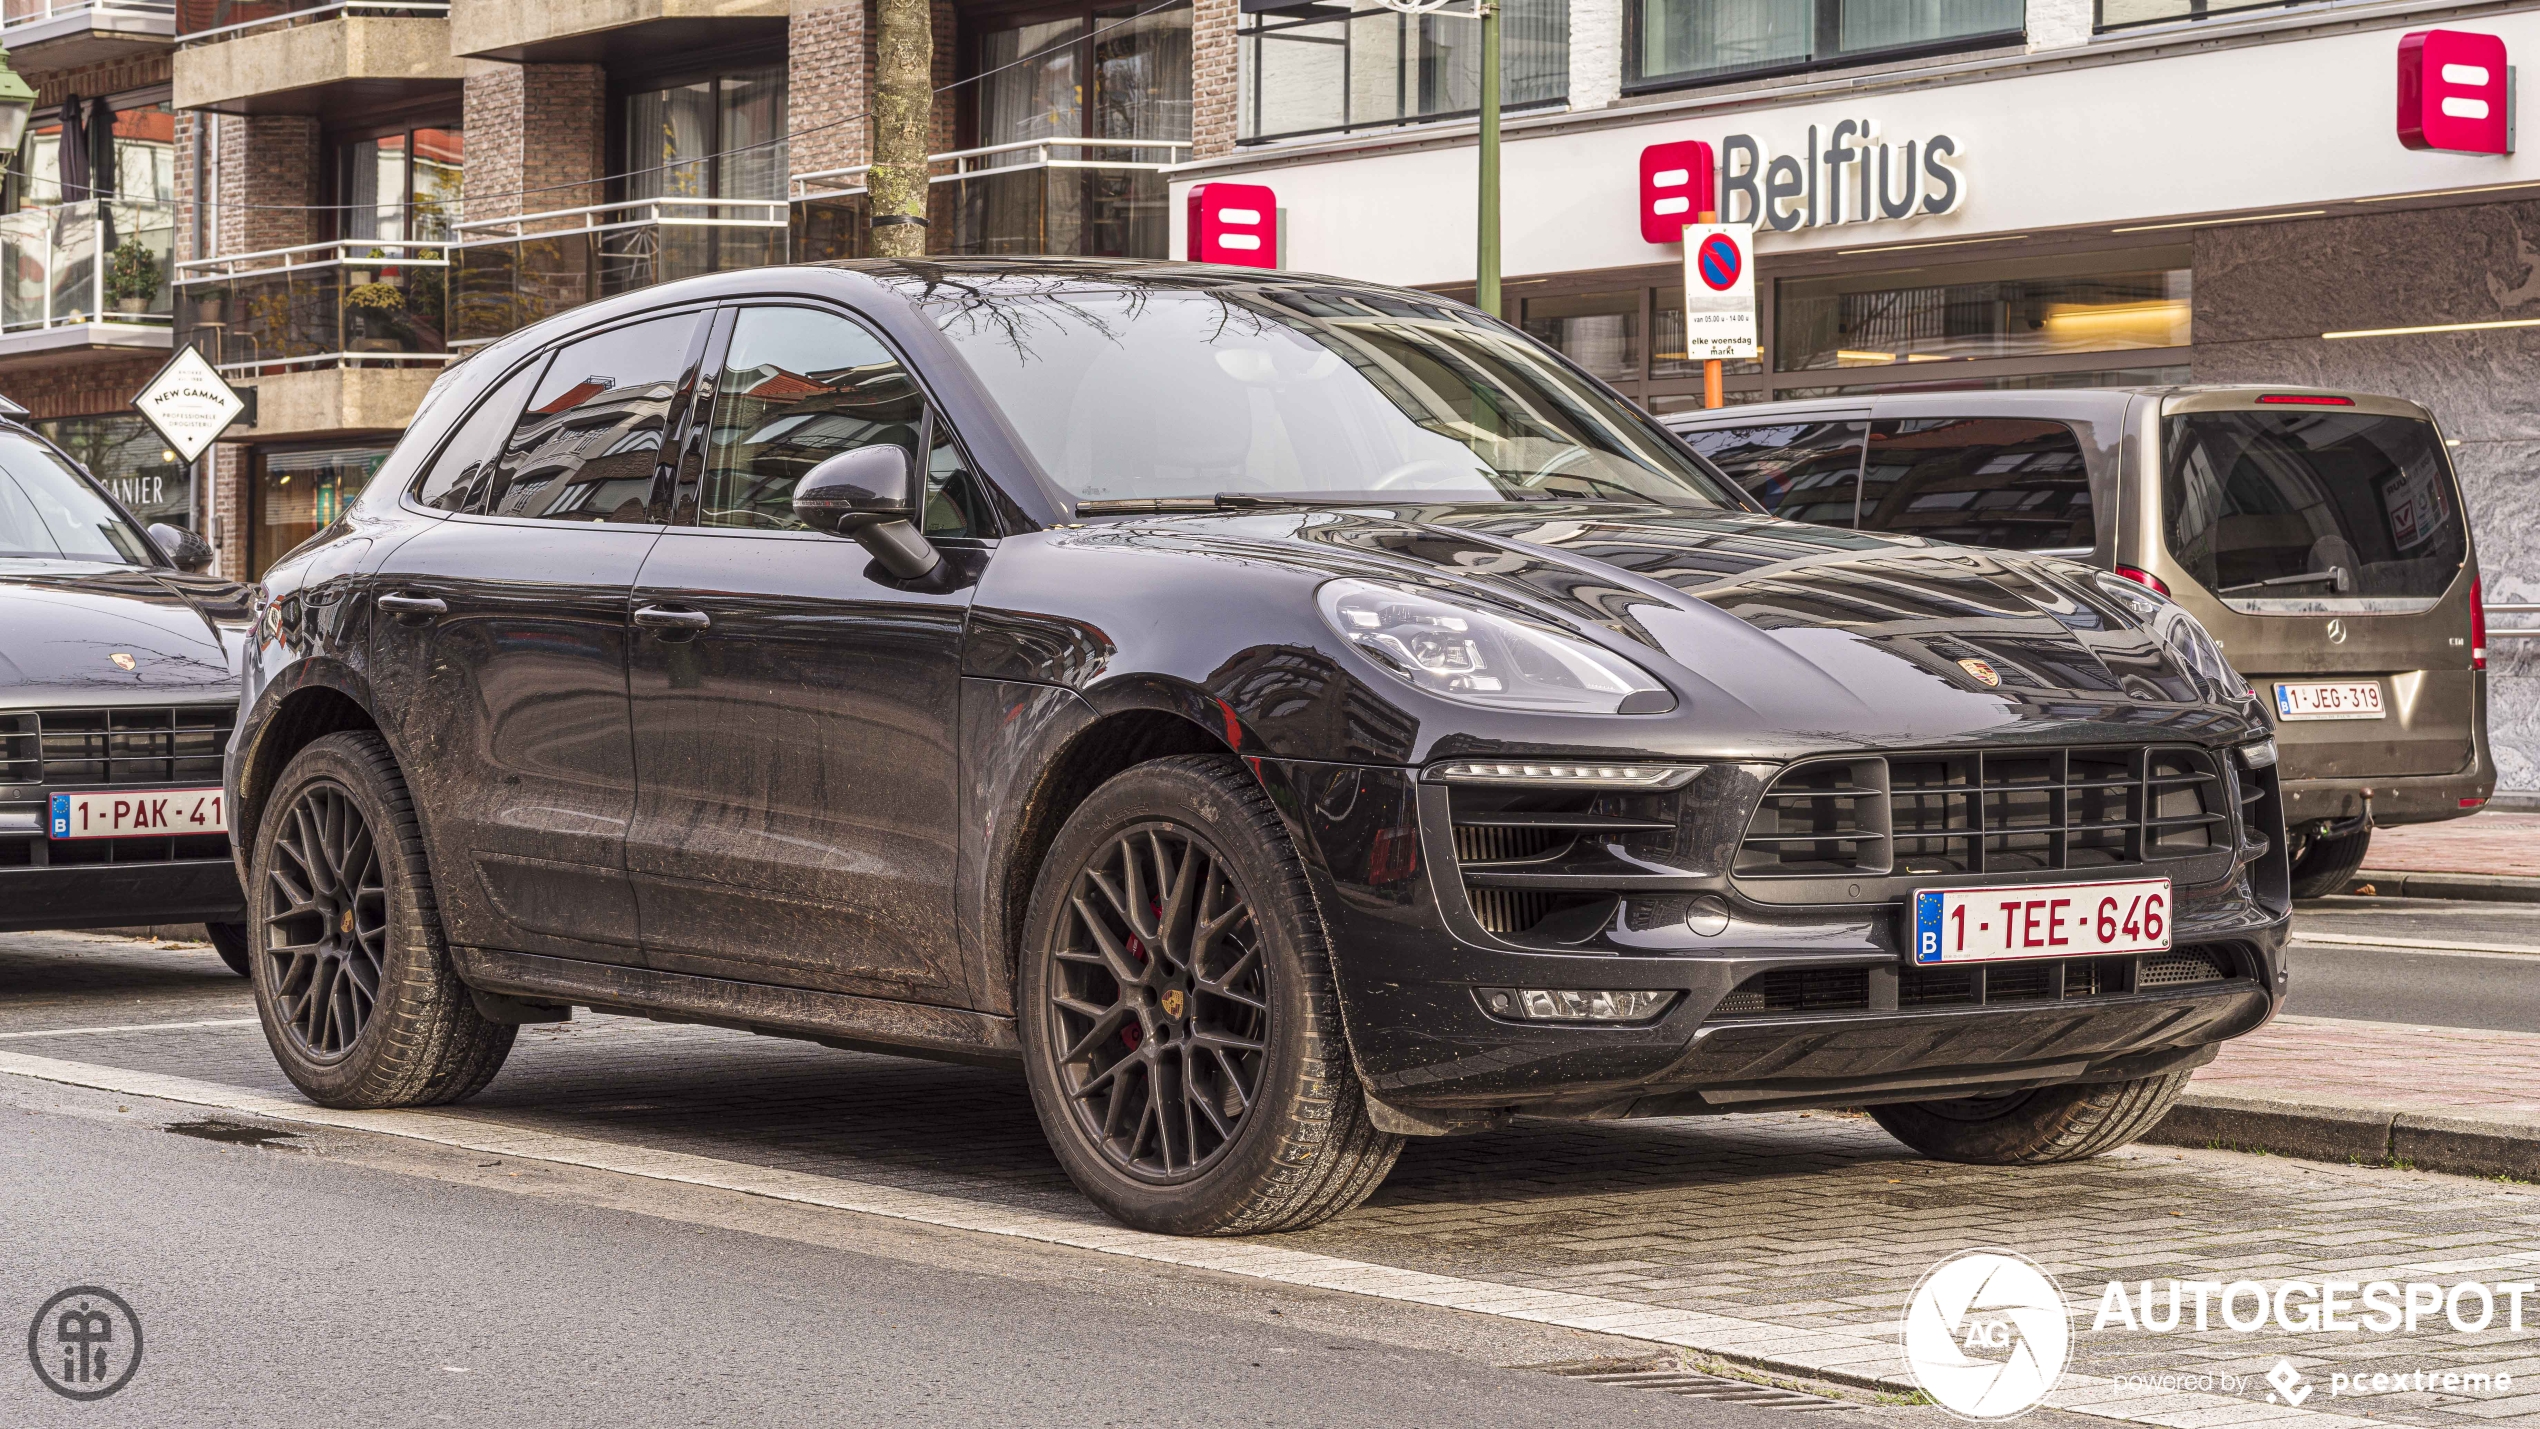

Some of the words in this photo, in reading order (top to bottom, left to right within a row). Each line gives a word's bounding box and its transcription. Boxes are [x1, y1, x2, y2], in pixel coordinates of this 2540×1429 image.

[1721, 118, 1959, 233] Belfius
[1692, 337, 1709, 345] elke
[1711, 336, 1752, 346] woensdag
[1710, 347, 1735, 355] markt
[154, 389, 180, 405] NEW
[183, 388, 225, 406] GAMMA
[162, 412, 217, 420] PROFESSIONELE
[2280, 700, 2290, 712] B
[2290, 687, 2379, 709] 1-JEG-319
[78, 796, 221, 830] 1-PAK-41
[54, 818, 66, 833] B
[1951, 893, 2165, 952] 1-TEE-646
[1922, 931, 1938, 954] B
